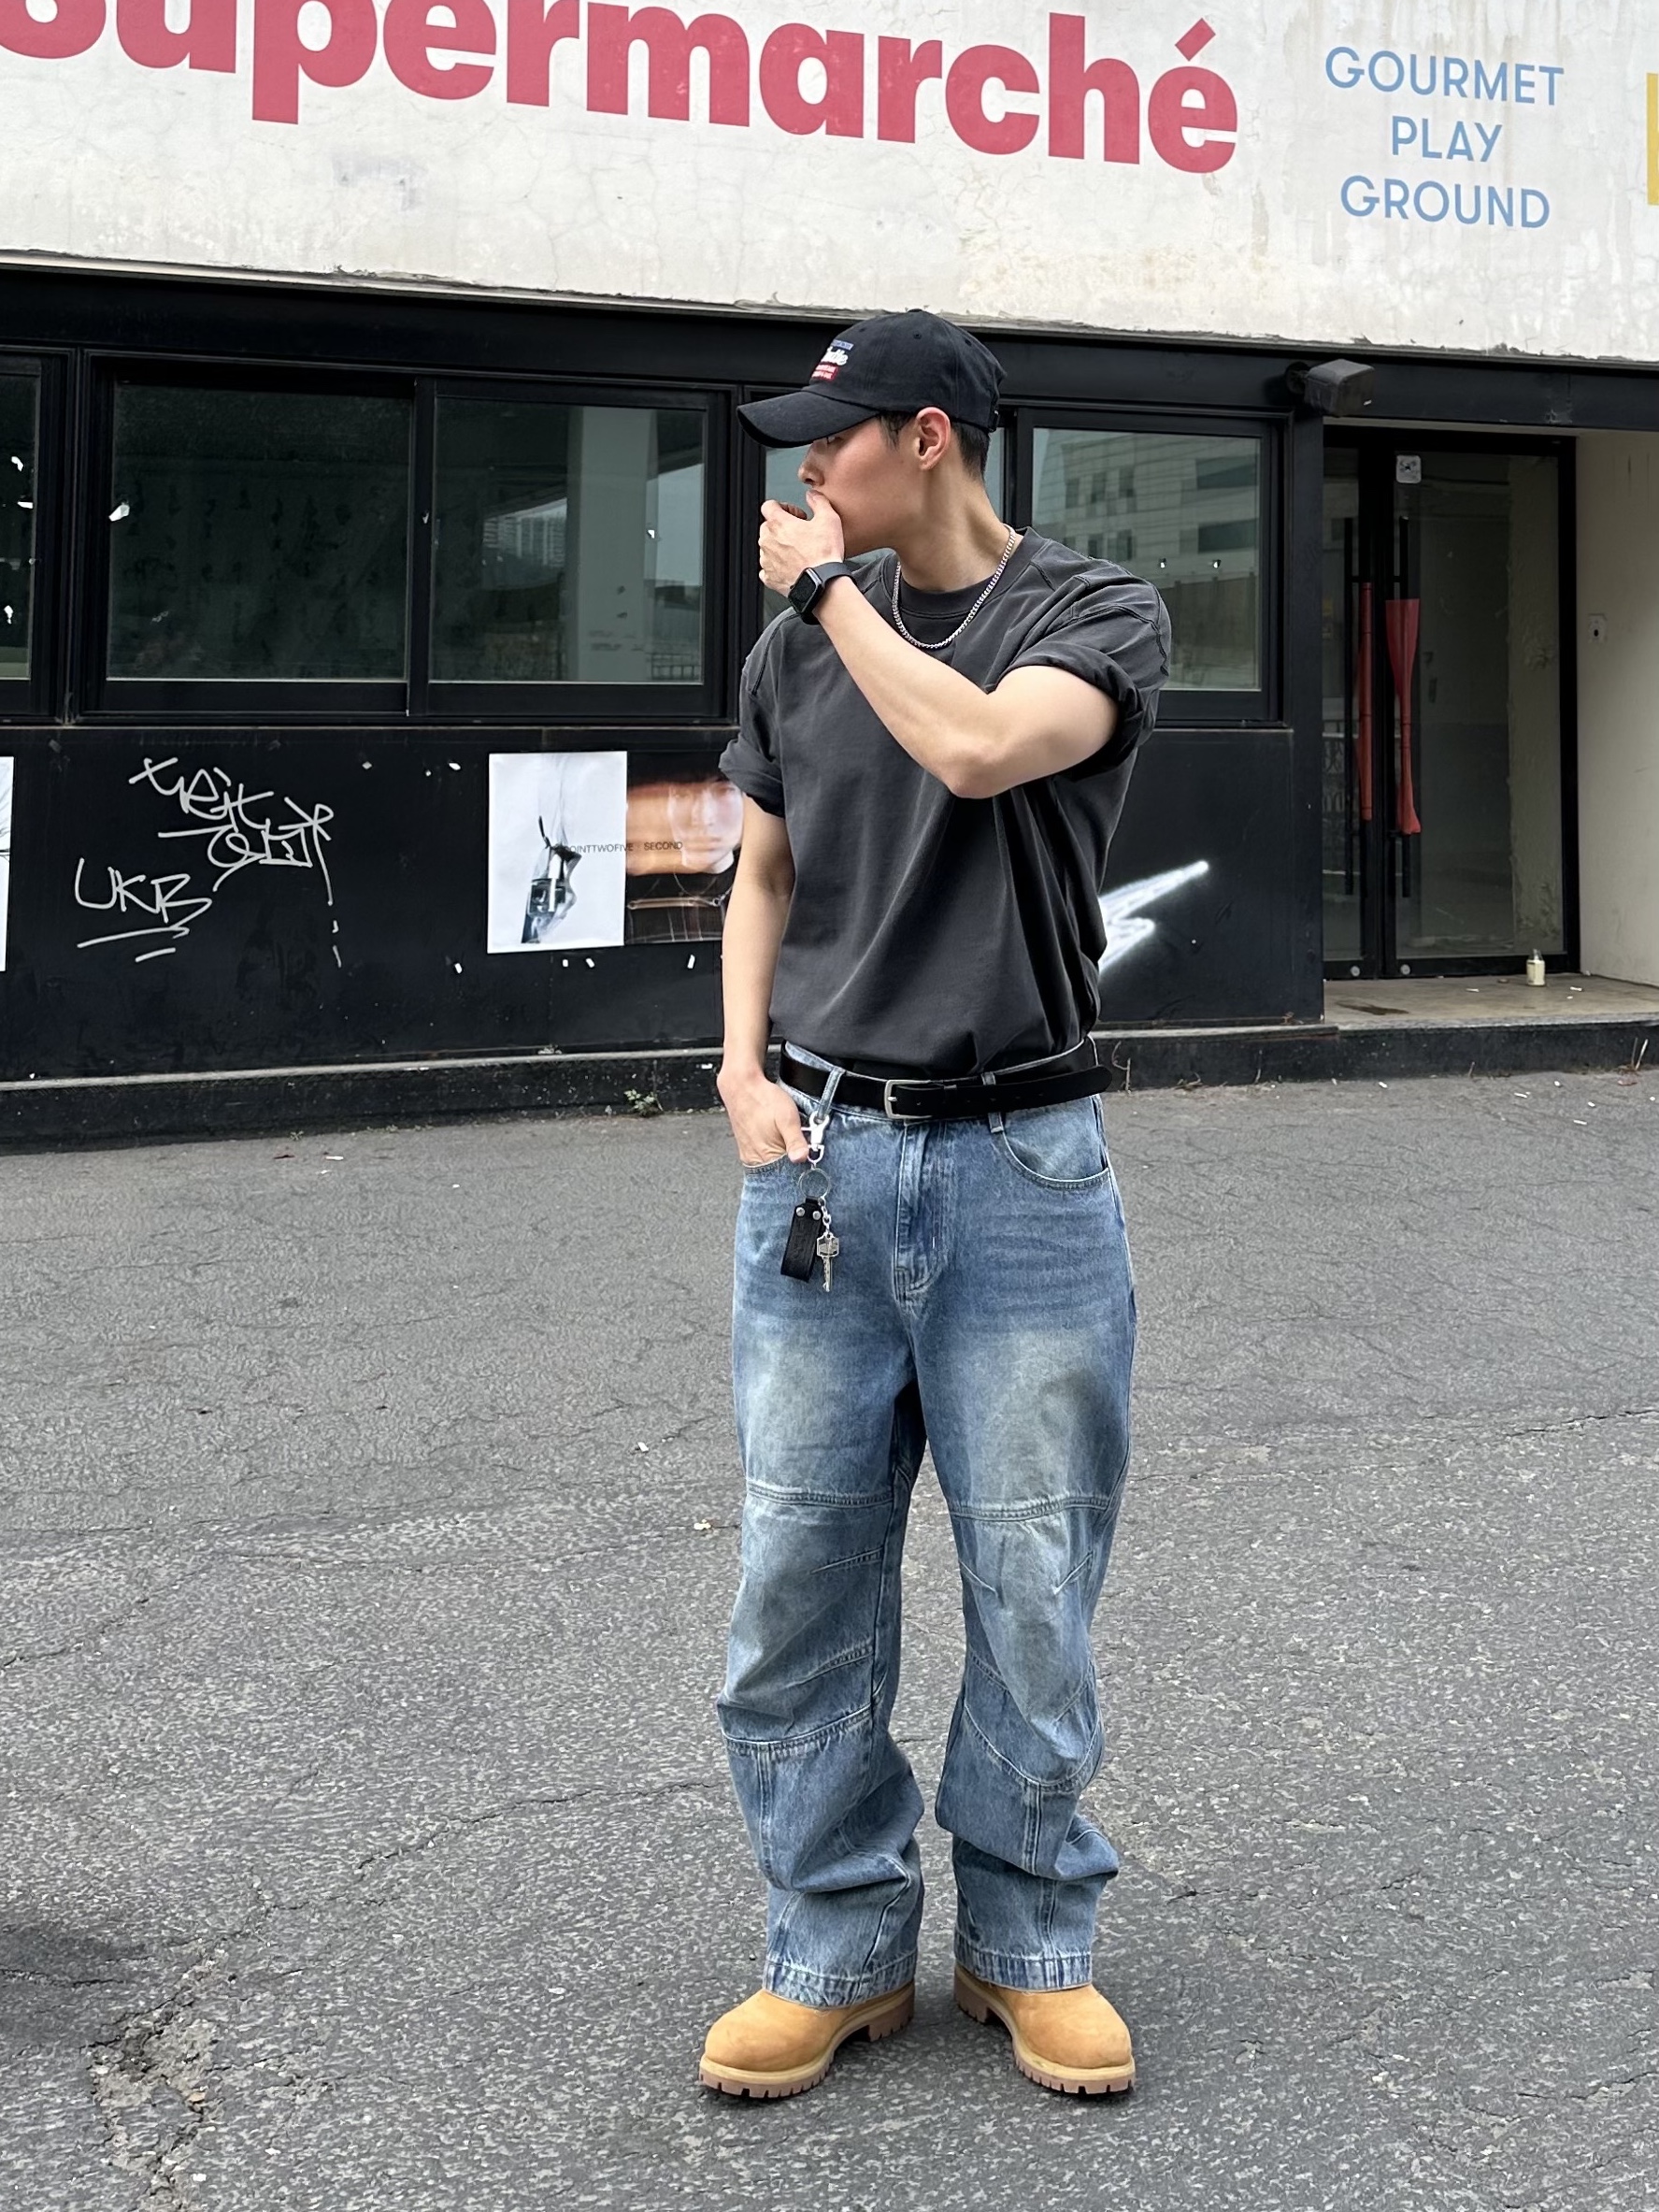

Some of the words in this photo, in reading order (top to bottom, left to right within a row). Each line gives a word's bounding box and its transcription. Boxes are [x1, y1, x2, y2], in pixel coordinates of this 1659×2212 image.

[1325, 47, 1565, 106] GOURMET
[1392, 116, 1502, 163] PLAY
[1341, 175, 1550, 228] GROUND
[565, 843, 634, 854] OINTTWOFIVE
[643, 841, 683, 852] SECOND
